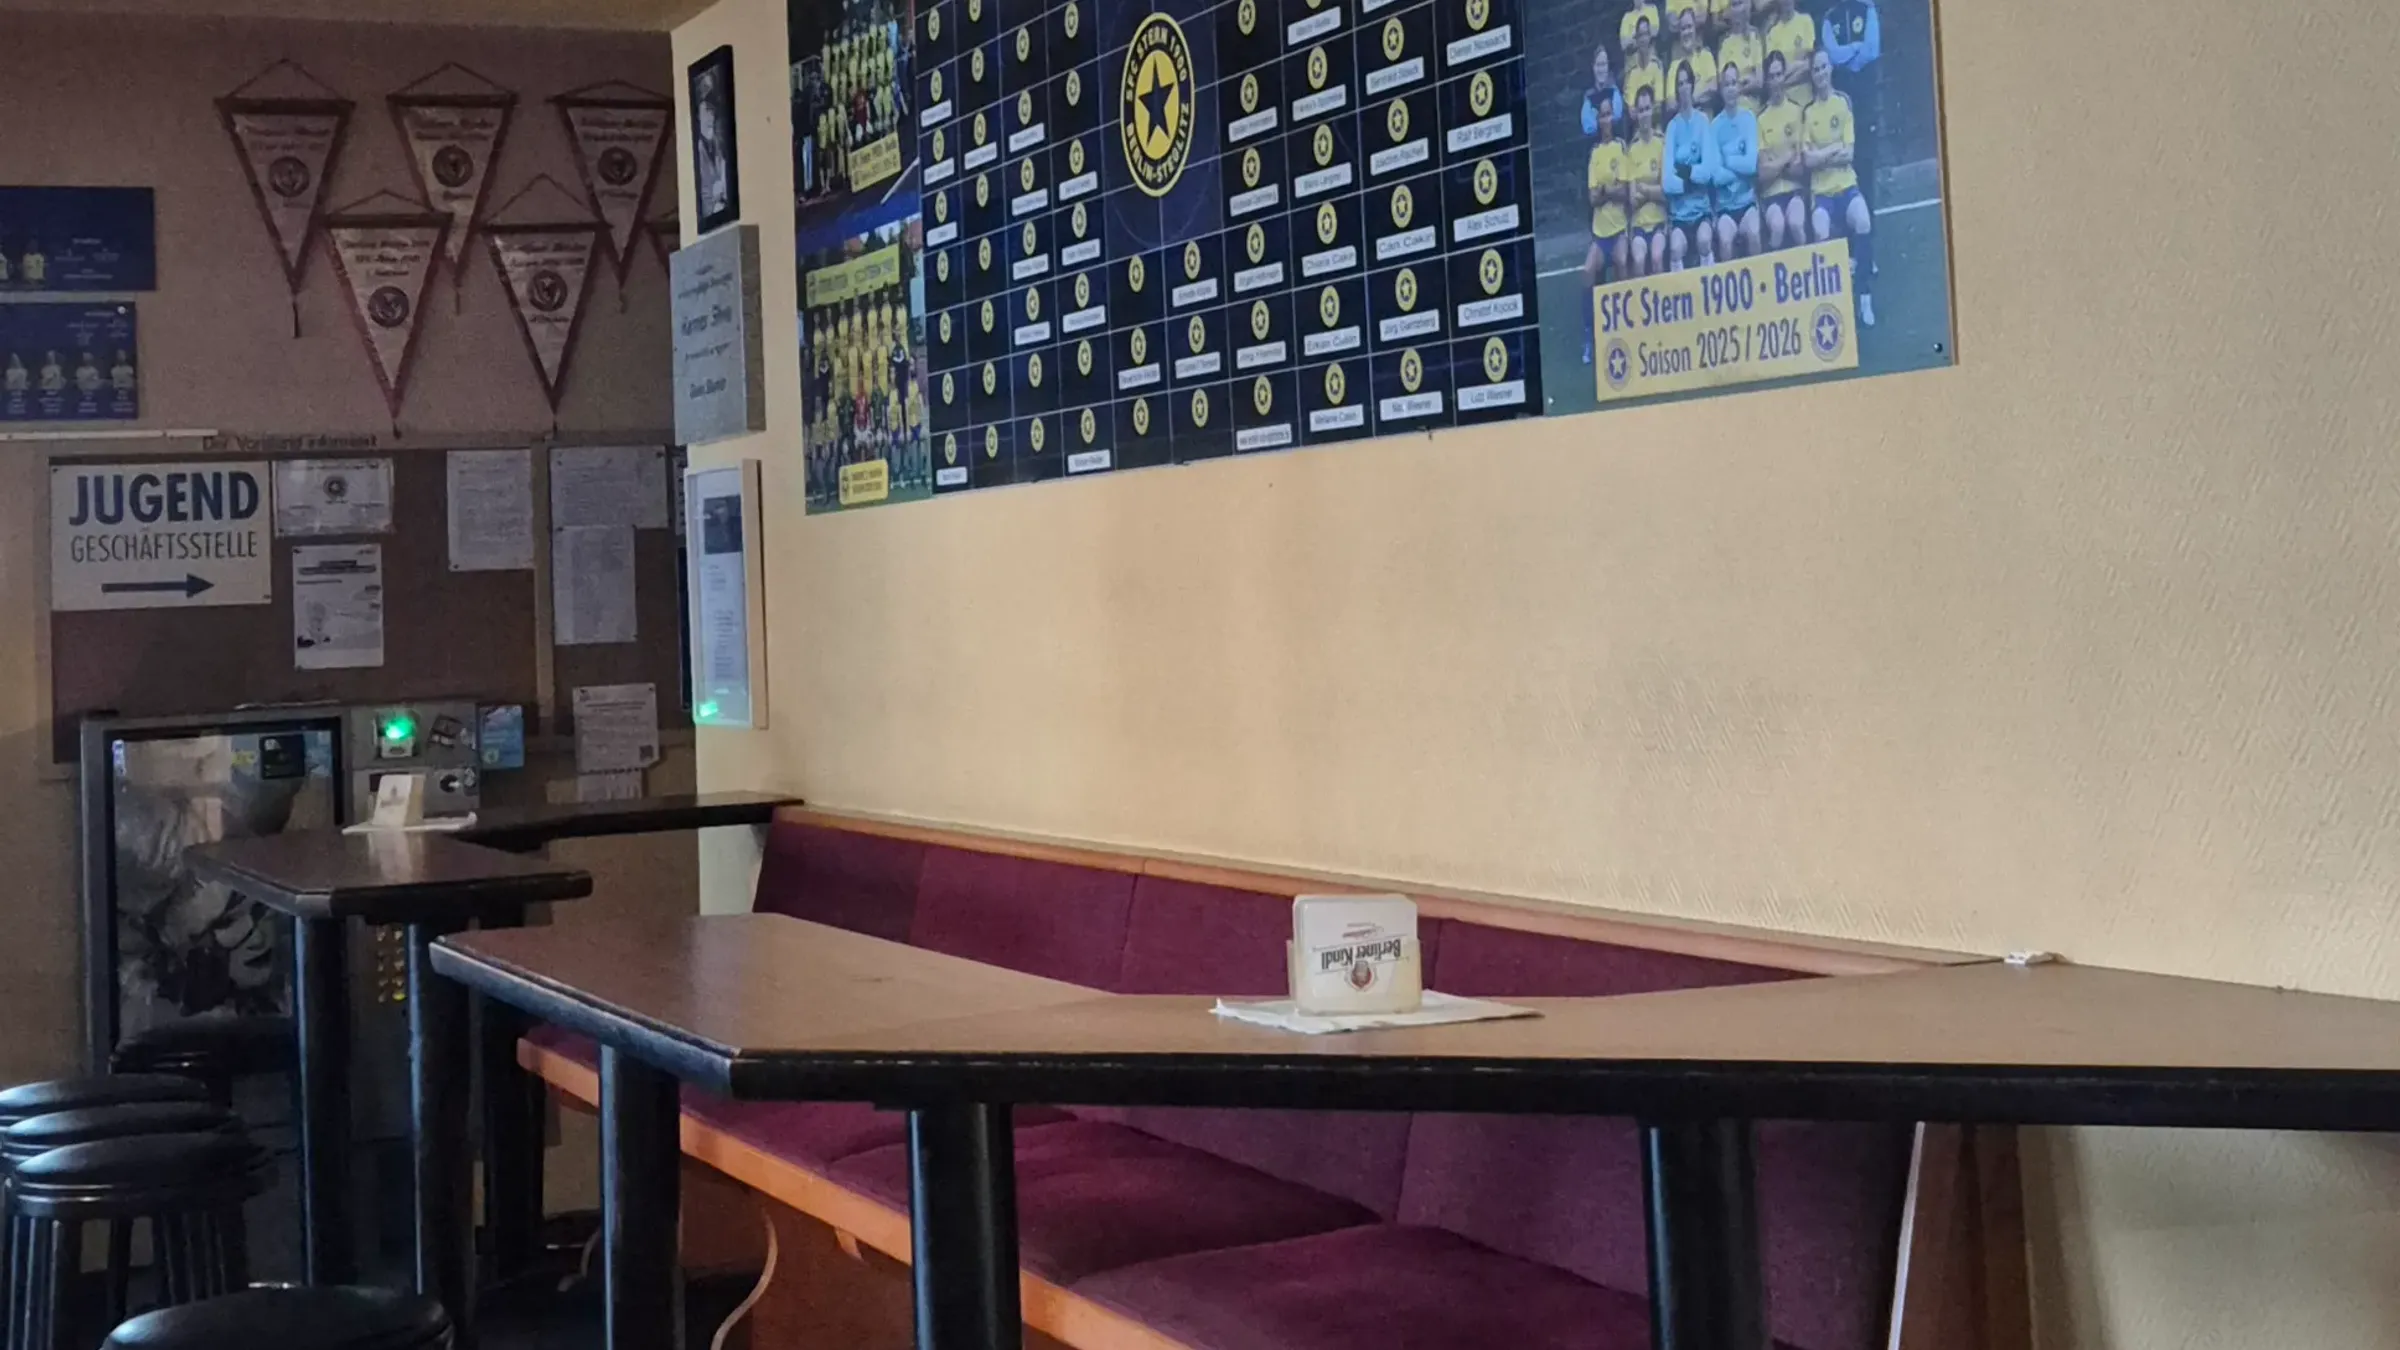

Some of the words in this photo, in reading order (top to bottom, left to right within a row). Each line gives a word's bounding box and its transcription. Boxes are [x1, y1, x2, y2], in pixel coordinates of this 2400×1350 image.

[1126, 59, 1138, 101] SFC
[1137, 26, 1168, 60] STERN
[1170, 35, 1187, 82] 1900
[1600, 289, 1635, 334] SFC
[1641, 286, 1695, 326] Stern
[1700, 266, 1752, 317] 1900
[1773, 251, 1842, 304] Berlin
[1638, 341, 1692, 378] Saison
[69, 471, 259, 526] JUGEND
[70, 526, 258, 563] GESCHÄFTSSTELLE
[1321, 949, 1353, 971] Kindl
[1354, 938, 1402, 962] Berliner
